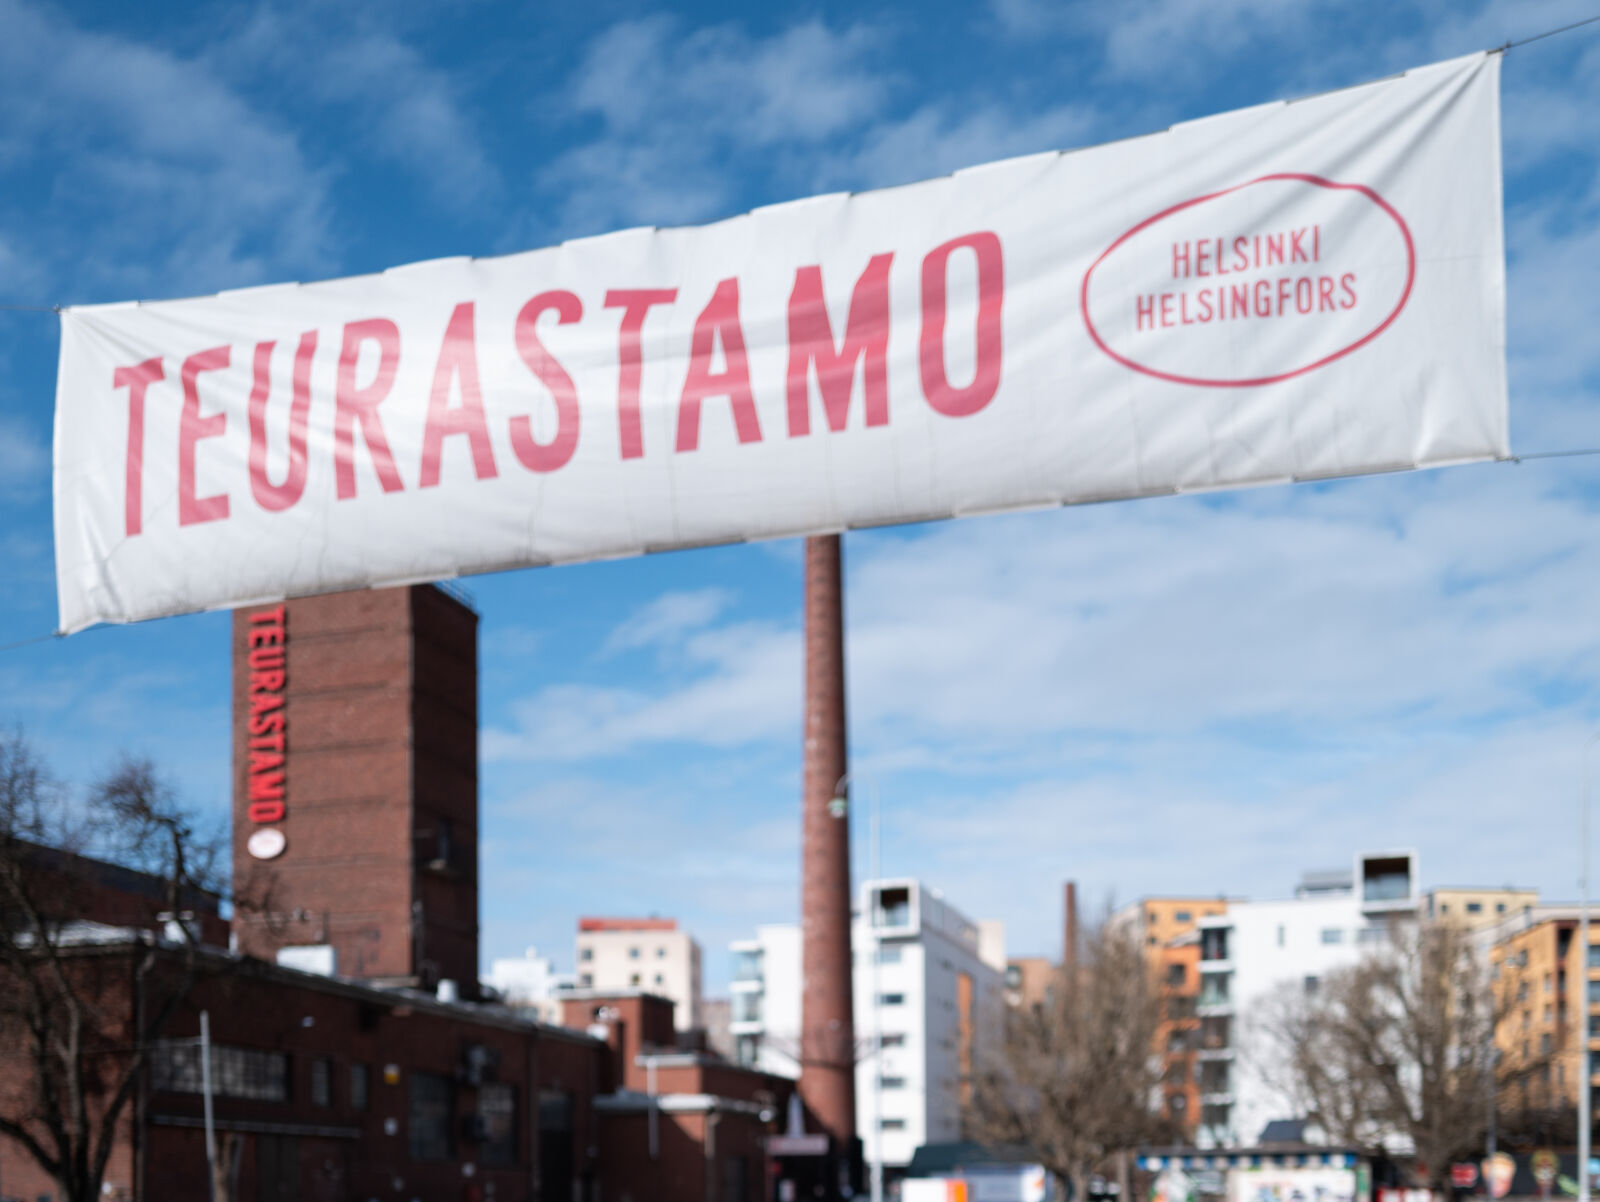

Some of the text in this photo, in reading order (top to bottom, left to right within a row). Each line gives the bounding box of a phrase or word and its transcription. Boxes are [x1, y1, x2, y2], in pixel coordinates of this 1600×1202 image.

[1136, 272, 1359, 331] HELSINGFORS
[1172, 224, 1321, 279] HELSINKI
[112, 230, 1005, 537] TEURASTAMO
[247, 603, 286, 824] TEURASTAMO
